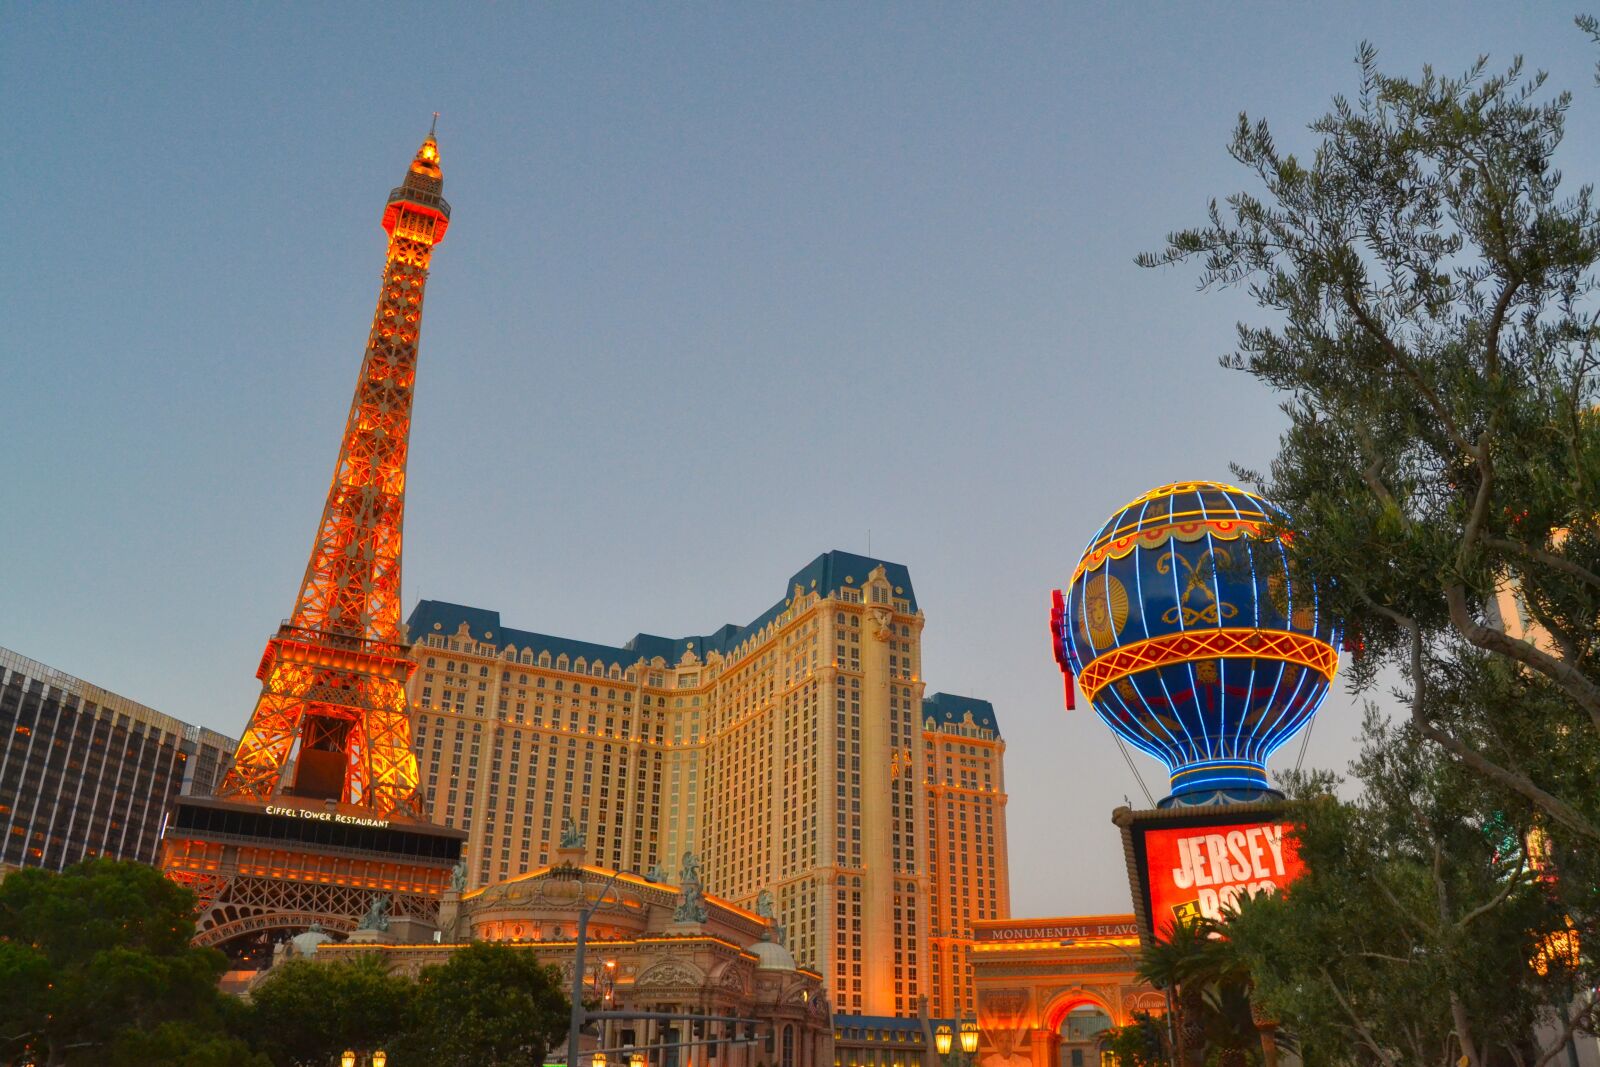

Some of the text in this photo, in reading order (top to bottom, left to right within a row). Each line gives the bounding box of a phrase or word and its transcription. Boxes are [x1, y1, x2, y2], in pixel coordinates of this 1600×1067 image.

[265, 805, 389, 828] EIFFEL TOWER RESTAURANT
[1172, 825, 1286, 889] JERSEY
[1198, 880, 1277, 939] BO
[992, 926, 1089, 939] MONUMENTAL
